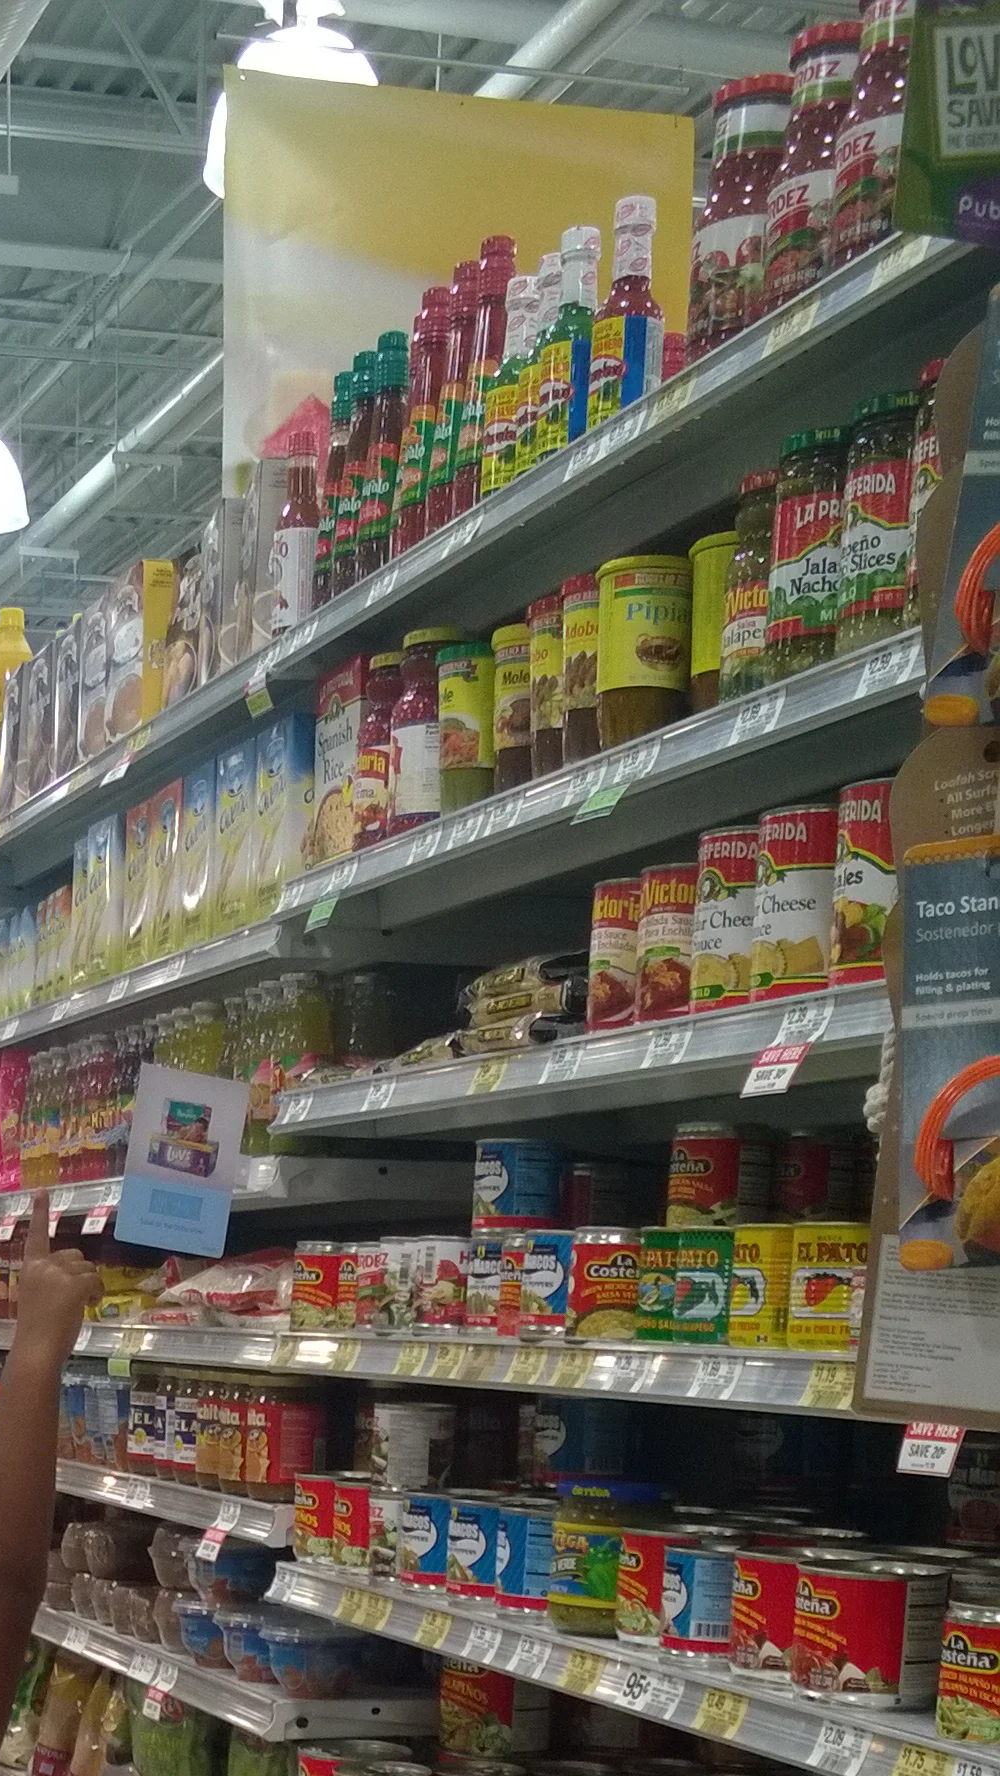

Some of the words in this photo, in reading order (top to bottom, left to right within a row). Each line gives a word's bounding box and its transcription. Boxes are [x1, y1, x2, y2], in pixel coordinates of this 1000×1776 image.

[958, 194, 1000, 221] Pub
[850, 550, 896, 573] Slices
[626, 602, 691, 625] Pipia
[323, 754, 345, 785] Rice
[951, 804, 982, 820] More
[762, 895, 816, 915] Cheese
[916, 899, 956, 919] Taco
[959, 896, 1000, 915] Stan
[709, 910, 754, 928] Chee
[915, 921, 995, 944] Sostenedor
[915, 971, 944, 983] Holds
[945, 968, 972, 981] tacos
[974, 966, 989, 977] for
[915, 984, 943, 998] filling
[945, 982, 954, 993] &
[956, 979, 991, 995] plating
[358, 1252, 388, 1269] RDEZ
[616, 1254, 633, 1268] La
[590, 1264, 639, 1279] Coste
[909, 1422, 933, 1438] SAVE
[934, 1424, 959, 1439] HERE
[908, 1443, 930, 1459] SAVE
[797, 1596, 832, 1615] steña
[951, 1635, 965, 1651] La
[901, 1746, 926, 1770] $1.75
